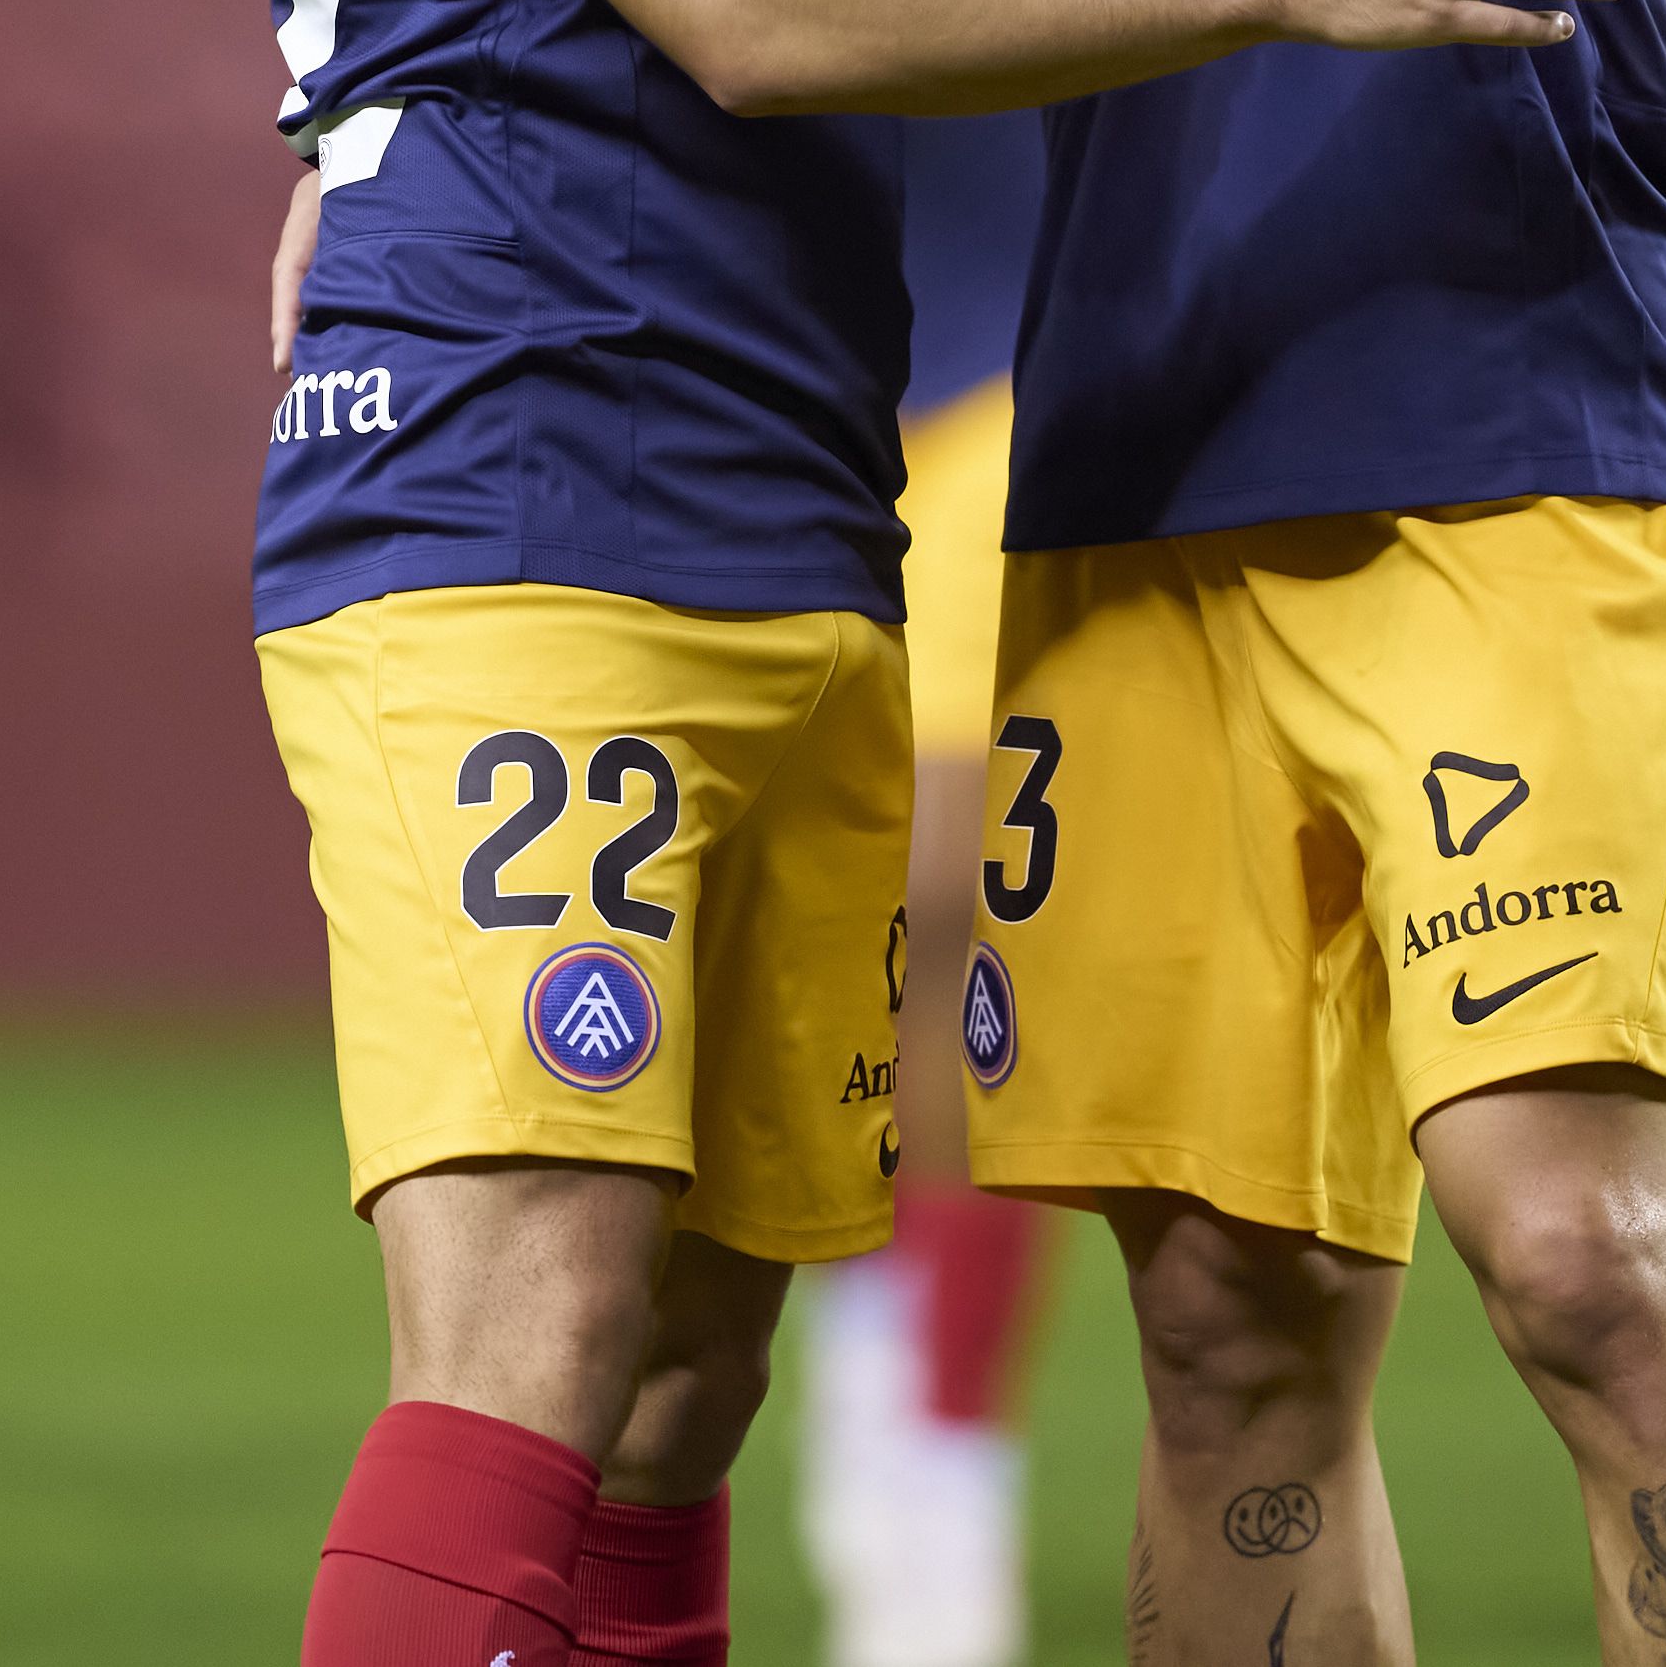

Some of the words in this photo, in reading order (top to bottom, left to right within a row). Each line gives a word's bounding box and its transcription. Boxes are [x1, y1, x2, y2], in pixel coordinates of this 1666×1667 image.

[269, 366, 399, 444] orra
[455, 728, 681, 944] 22
[981, 713, 1063, 925] 3
[1403, 879, 1623, 970] Andorra
